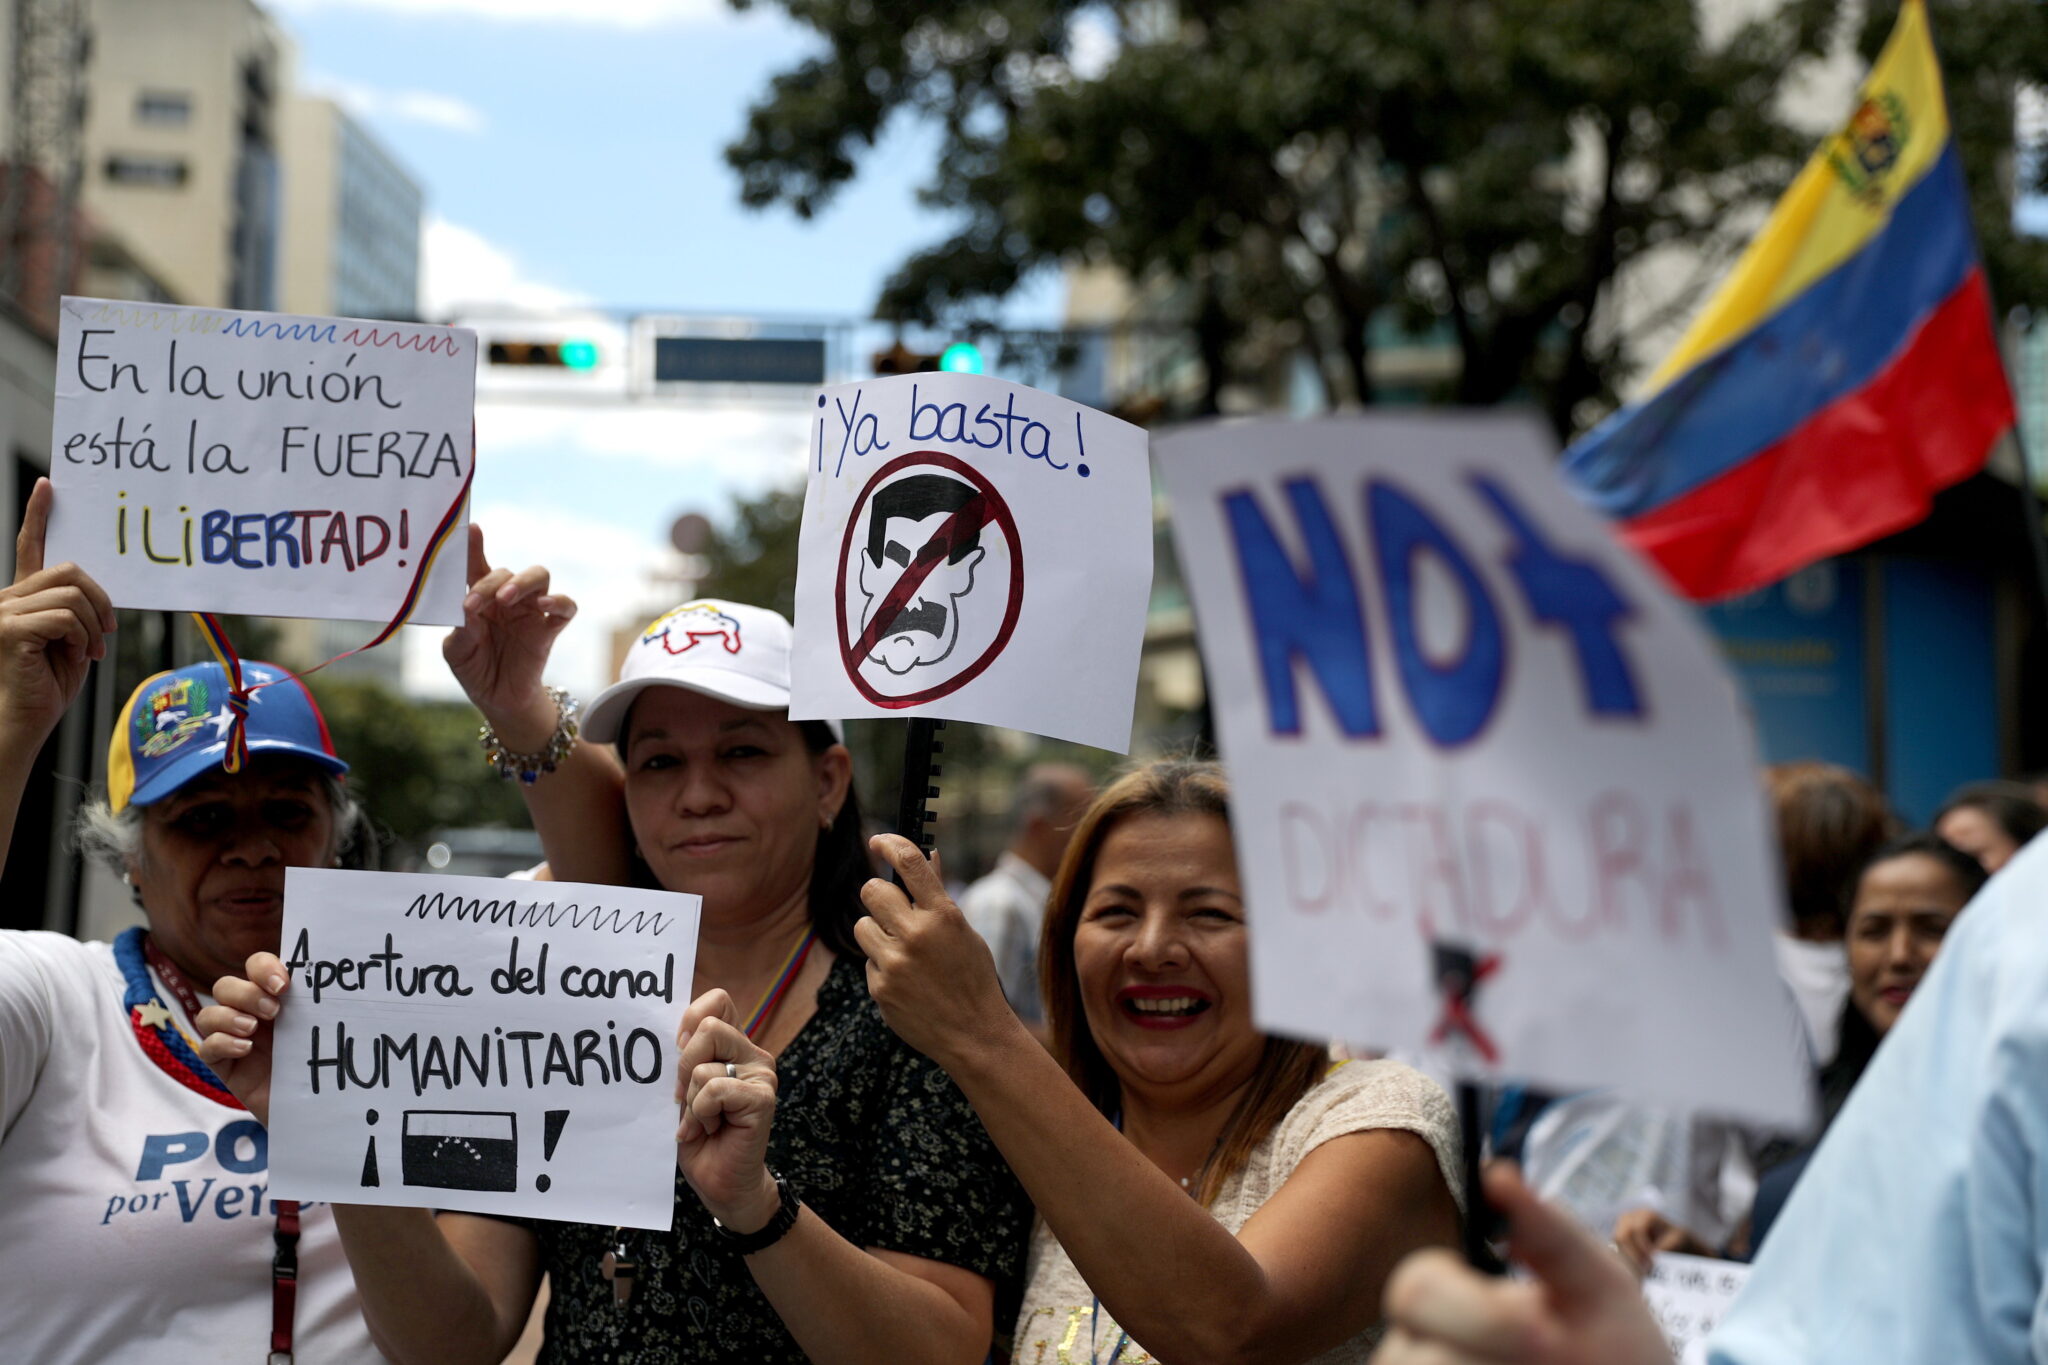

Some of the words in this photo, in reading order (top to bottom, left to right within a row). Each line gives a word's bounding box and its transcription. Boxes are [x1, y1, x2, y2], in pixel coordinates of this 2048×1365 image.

[77, 329, 149, 394] En
[168, 339, 224, 401] la
[237, 353, 403, 408] unión
[63, 416, 171, 470] está
[187, 418, 250, 475] la
[280, 426, 463, 480] FUERZA
[817, 388, 890, 478] ¡Ya
[908, 383, 1091, 478] basta!
[285, 927, 474, 1004] Apertura
[490, 935, 550, 996] del
[560, 952, 675, 1004] canal
[135, 1119, 268, 1182] PO
[100, 1190, 170, 1226] por
